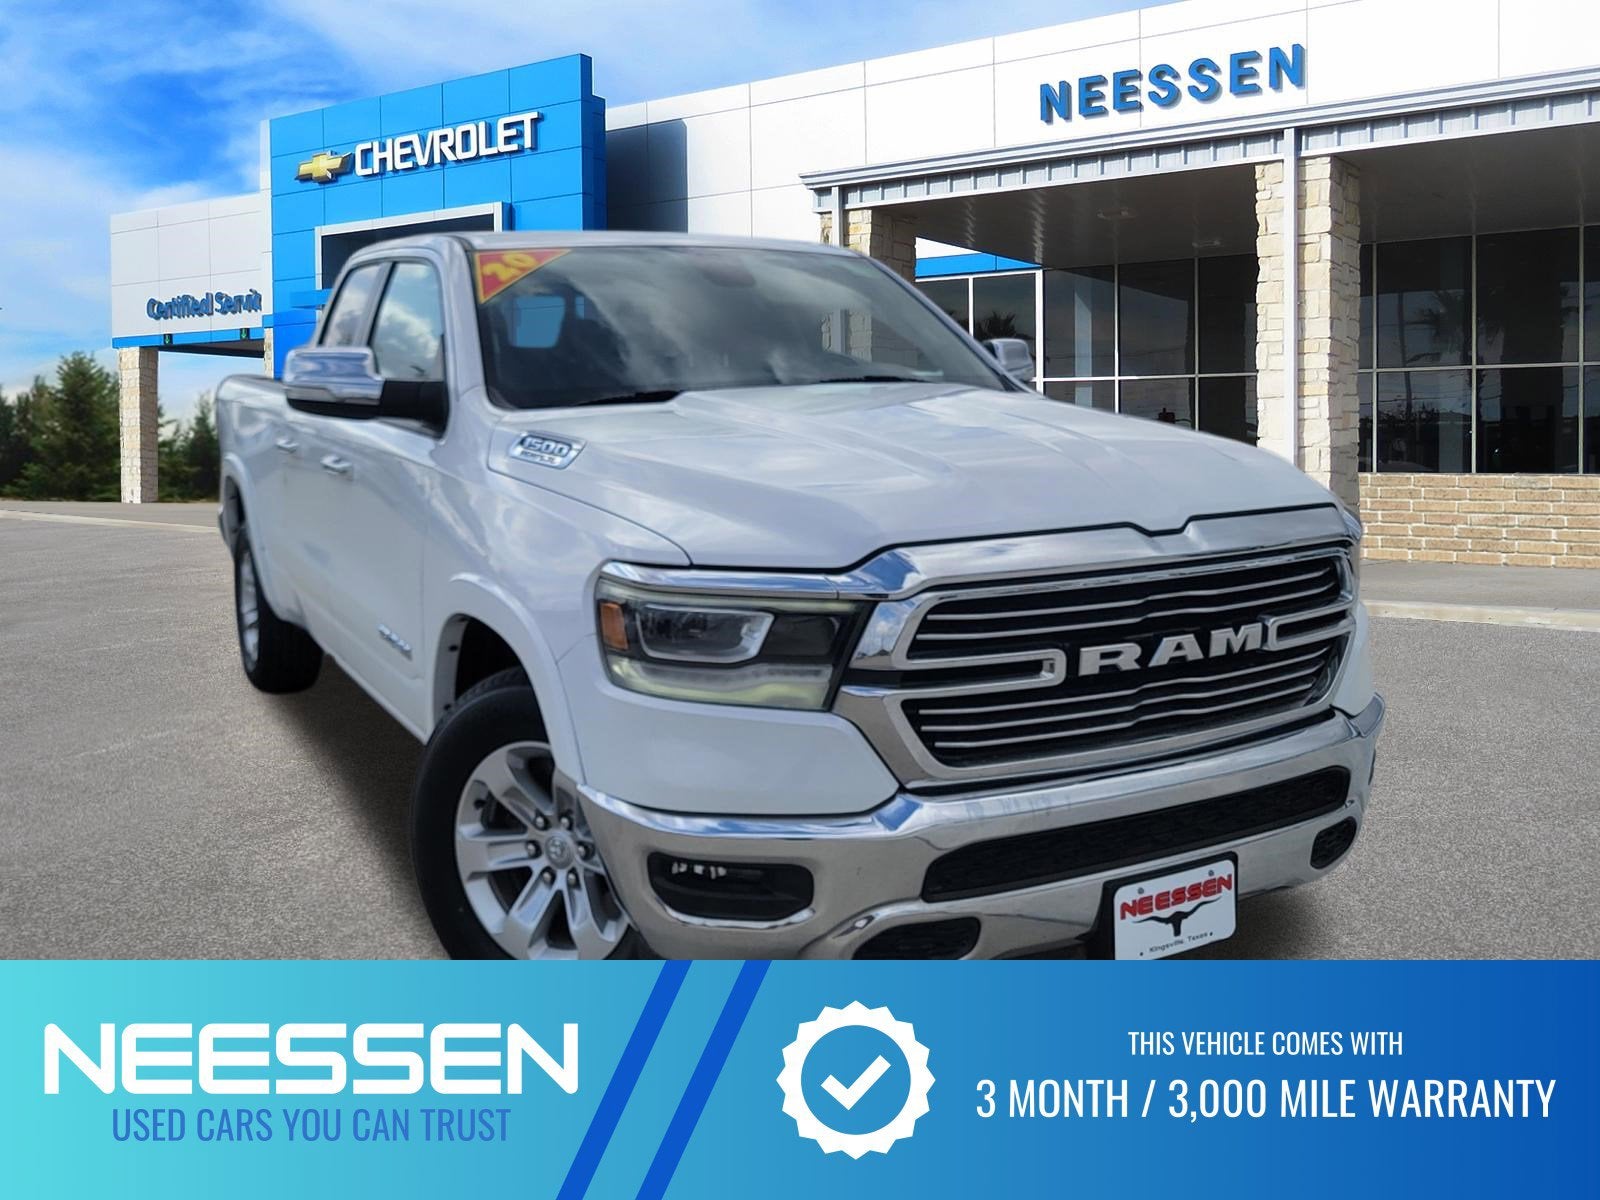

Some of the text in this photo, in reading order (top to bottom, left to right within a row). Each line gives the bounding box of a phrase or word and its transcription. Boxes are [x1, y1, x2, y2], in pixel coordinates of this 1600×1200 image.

[1040, 43, 1305, 124] NEESSEN
[355, 111, 543, 178] CHEVROLET
[147, 292, 214, 321] Certified
[522, 436, 571, 458] 1500
[1078, 622, 1263, 677] RAM
[1120, 873, 1232, 921] NEESSEN
